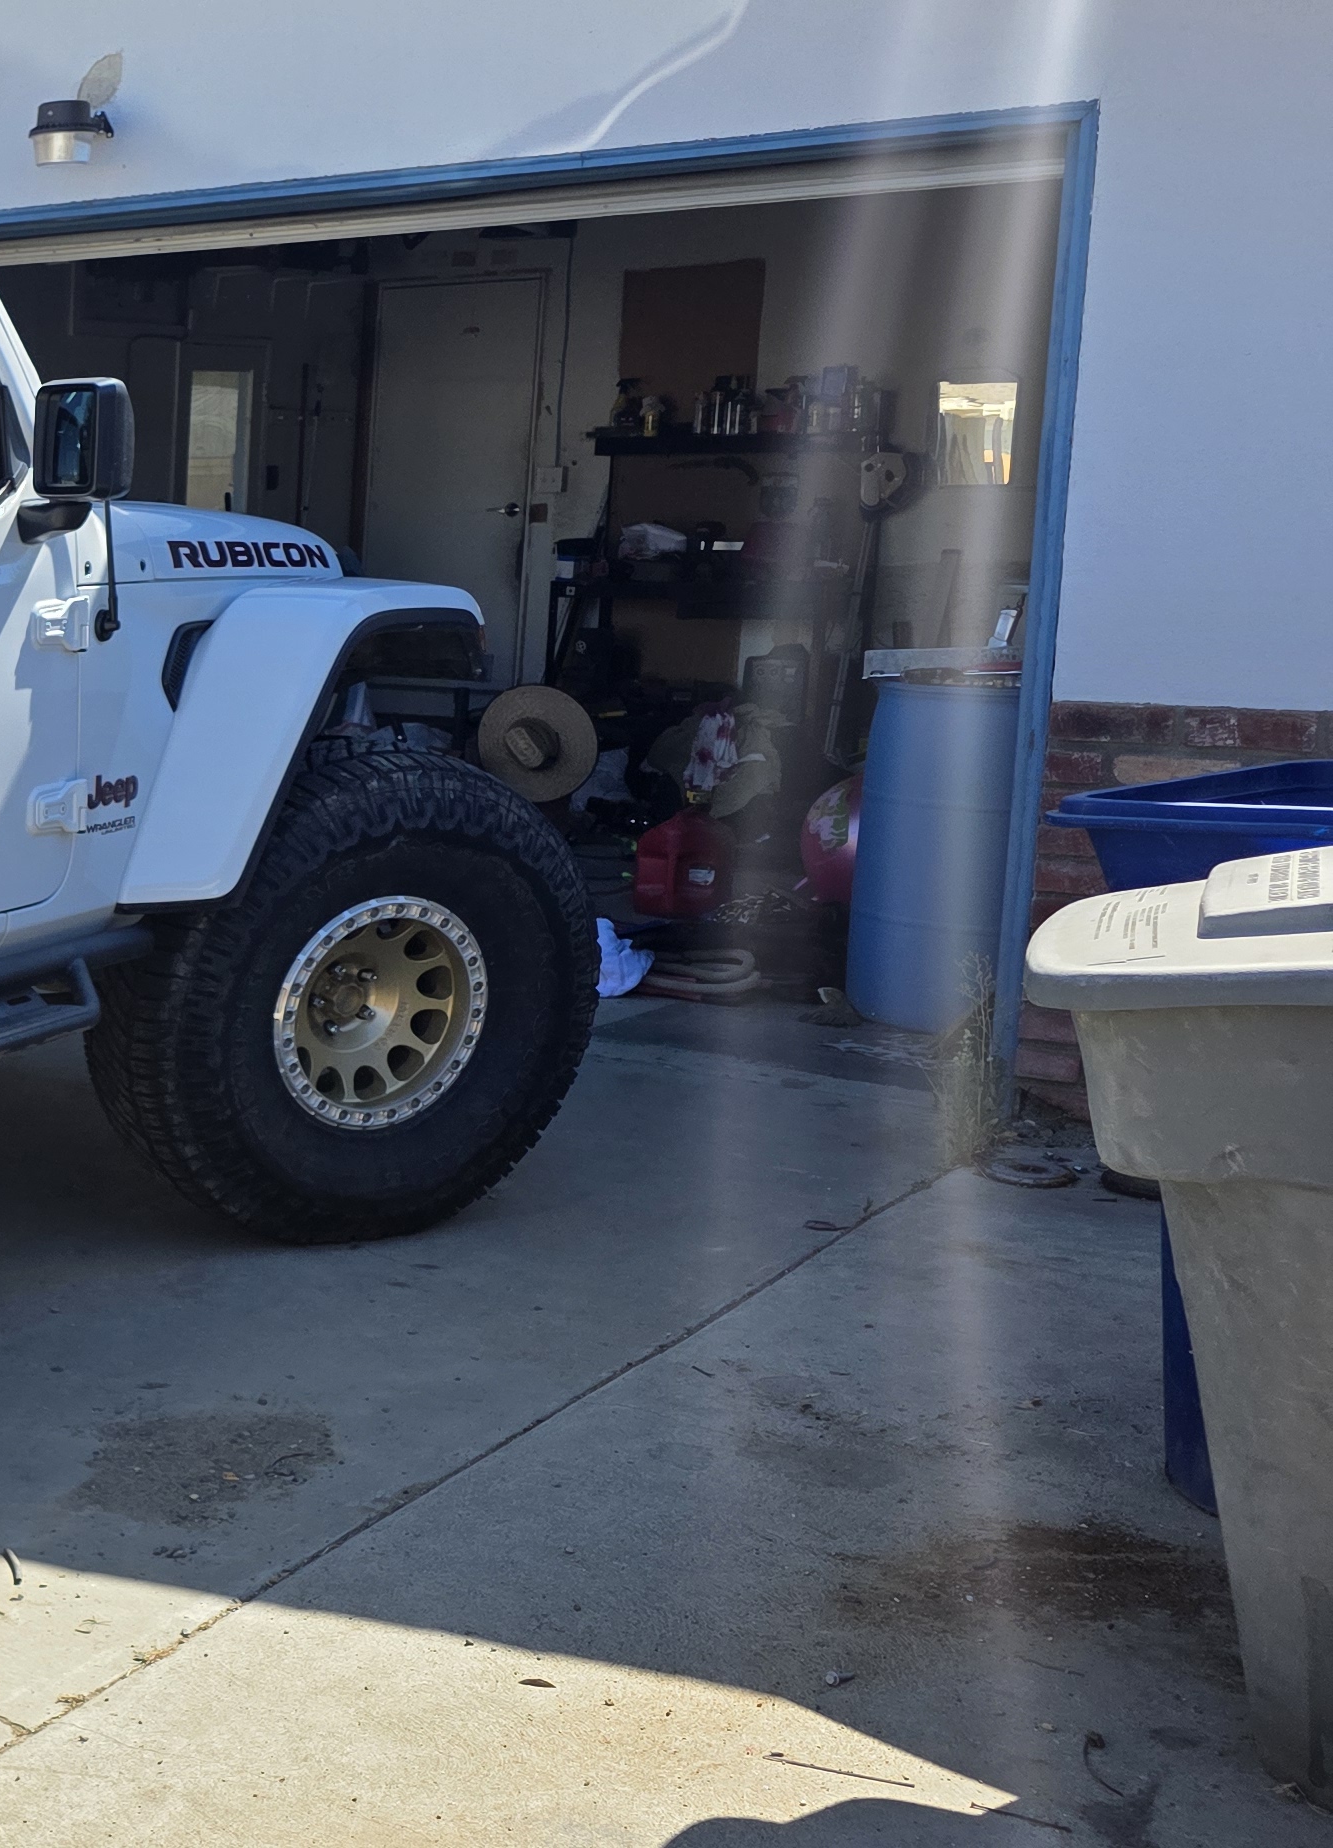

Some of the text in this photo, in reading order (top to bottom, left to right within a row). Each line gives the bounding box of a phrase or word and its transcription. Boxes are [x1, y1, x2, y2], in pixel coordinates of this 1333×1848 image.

[166, 540, 331, 569] RUBICON
[87, 774, 139, 810] Jeep
[86, 815, 136, 834] WRANGLER
